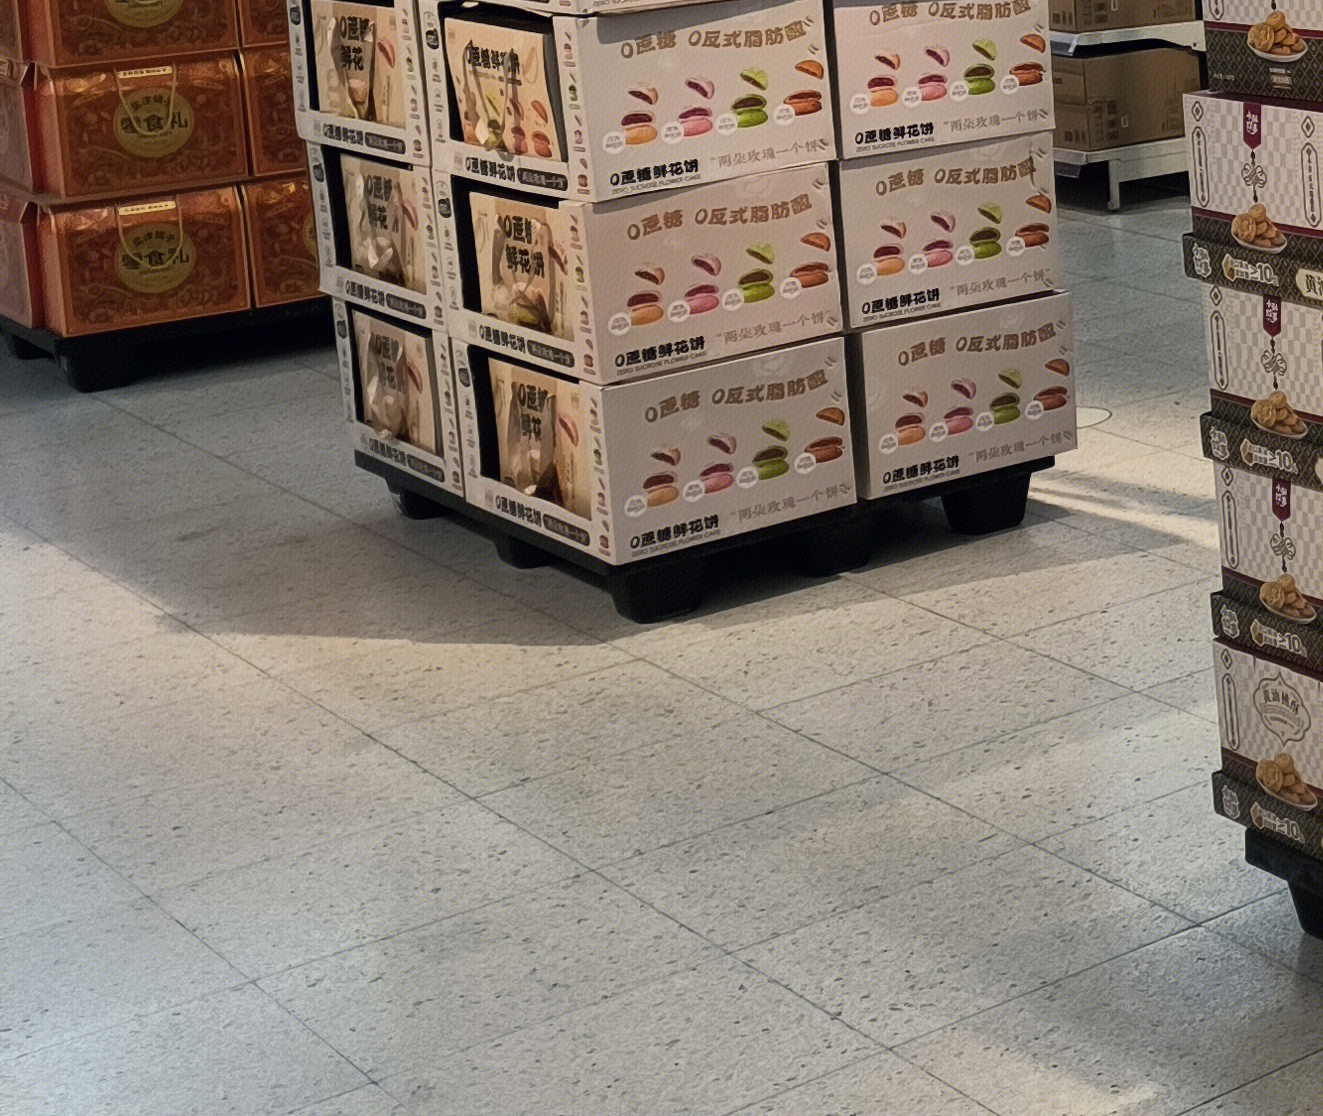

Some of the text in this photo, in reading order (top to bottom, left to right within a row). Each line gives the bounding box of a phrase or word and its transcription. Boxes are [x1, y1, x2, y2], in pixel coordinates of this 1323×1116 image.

[869, 1, 918, 26] 0蔗糖
[621, 20, 807, 59] 0蔗糖 0反式脂肪酸
[855, 122, 934, 145] 0蔗糖鲜花饼
[610, 159, 699, 186] 0蔗糖鲜花饼
[876, 156, 1035, 196] 0蔗糖 0反式脂肪酸
[627, 193, 812, 240] 0蔗糖 0反式脂肪酸
[862, 288, 939, 314] 0蔗糖鲜花饼
[615, 336, 705, 368] 0蔗糖鲜花饼
[898, 322, 1056, 366] 0蔗糖 0反式脂肪酸
[645, 369, 828, 422] 0蔗糖 0反式脂肪酸
[883, 456, 959, 484] 0蔗糖鲜花饼
[630, 515, 719, 549] 0蔗糖鲜花饼
